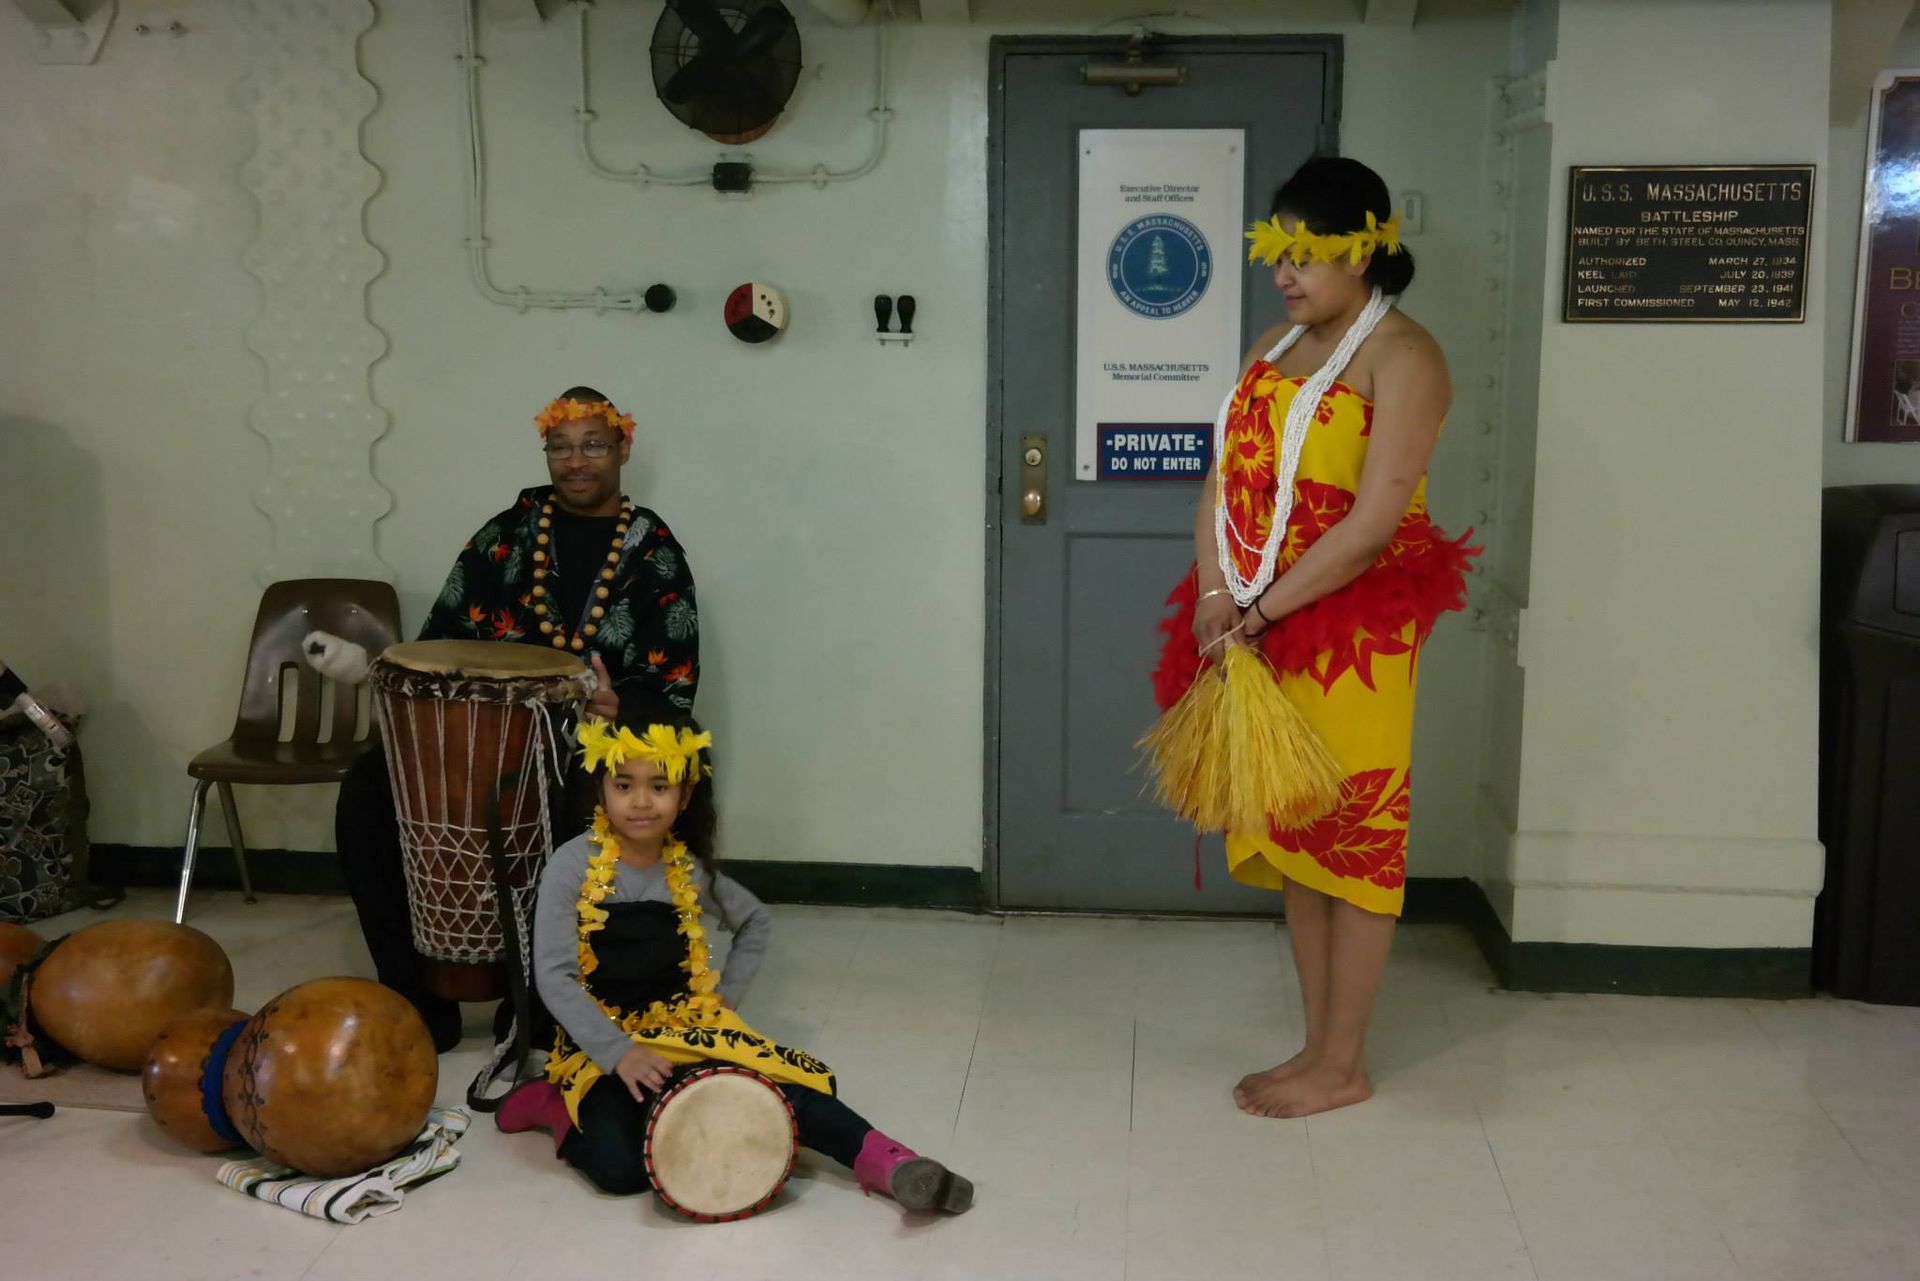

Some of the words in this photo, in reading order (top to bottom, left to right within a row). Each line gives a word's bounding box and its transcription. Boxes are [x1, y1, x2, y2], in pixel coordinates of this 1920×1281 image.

[1120, 184, 1162, 193] Executive
[1163, 184, 1200, 193] Director
[1646, 182, 1802, 202] MASSACHUSETTS
[1124, 194, 1142, 203] and
[1143, 194, 1163, 203] Staff
[1164, 194, 1194, 203] Offices
[1641, 210, 1739, 223] BATTLESHIP
[1574, 226, 1613, 236] NAMED
[1615, 226, 1636, 236] FOR
[1639, 226, 1660, 236] THE
[1661, 226, 1695, 236] STATE
[1697, 226, 1713, 236] OF
[1714, 226, 1806, 236] MASSACHUSETTS
[1578, 237, 1610, 247] BUILT
[1616, 237, 1631, 247] BY
[1671, 237, 1705, 247] STEEL
[1578, 257, 1648, 267] AUTHORIZED
[1708, 257, 1749, 267] MARCH
[1577, 270, 1606, 280] KEEL
[1720, 270, 1747, 279] JULY
[1577, 284, 1637, 294] LAUNCHED
[1679, 284, 1746, 294] SEPTEMBER
[1772, 283, 1794, 294] 1941
[1577, 298, 1609, 308] FIRST
[1613, 298, 1696, 308] COMMISSIONED
[1718, 298, 1741, 308] MAY
[1767, 298, 1793, 308] 1942
[1129, 363, 1210, 372] MASSACHUSETTS
[1112, 373, 1152, 381] Memorial
[1153, 373, 1201, 382] Committee
[1111, 457, 1128, 471] DO
[1133, 457, 1157, 471] NOT
[1163, 457, 1201, 471] ENTER
